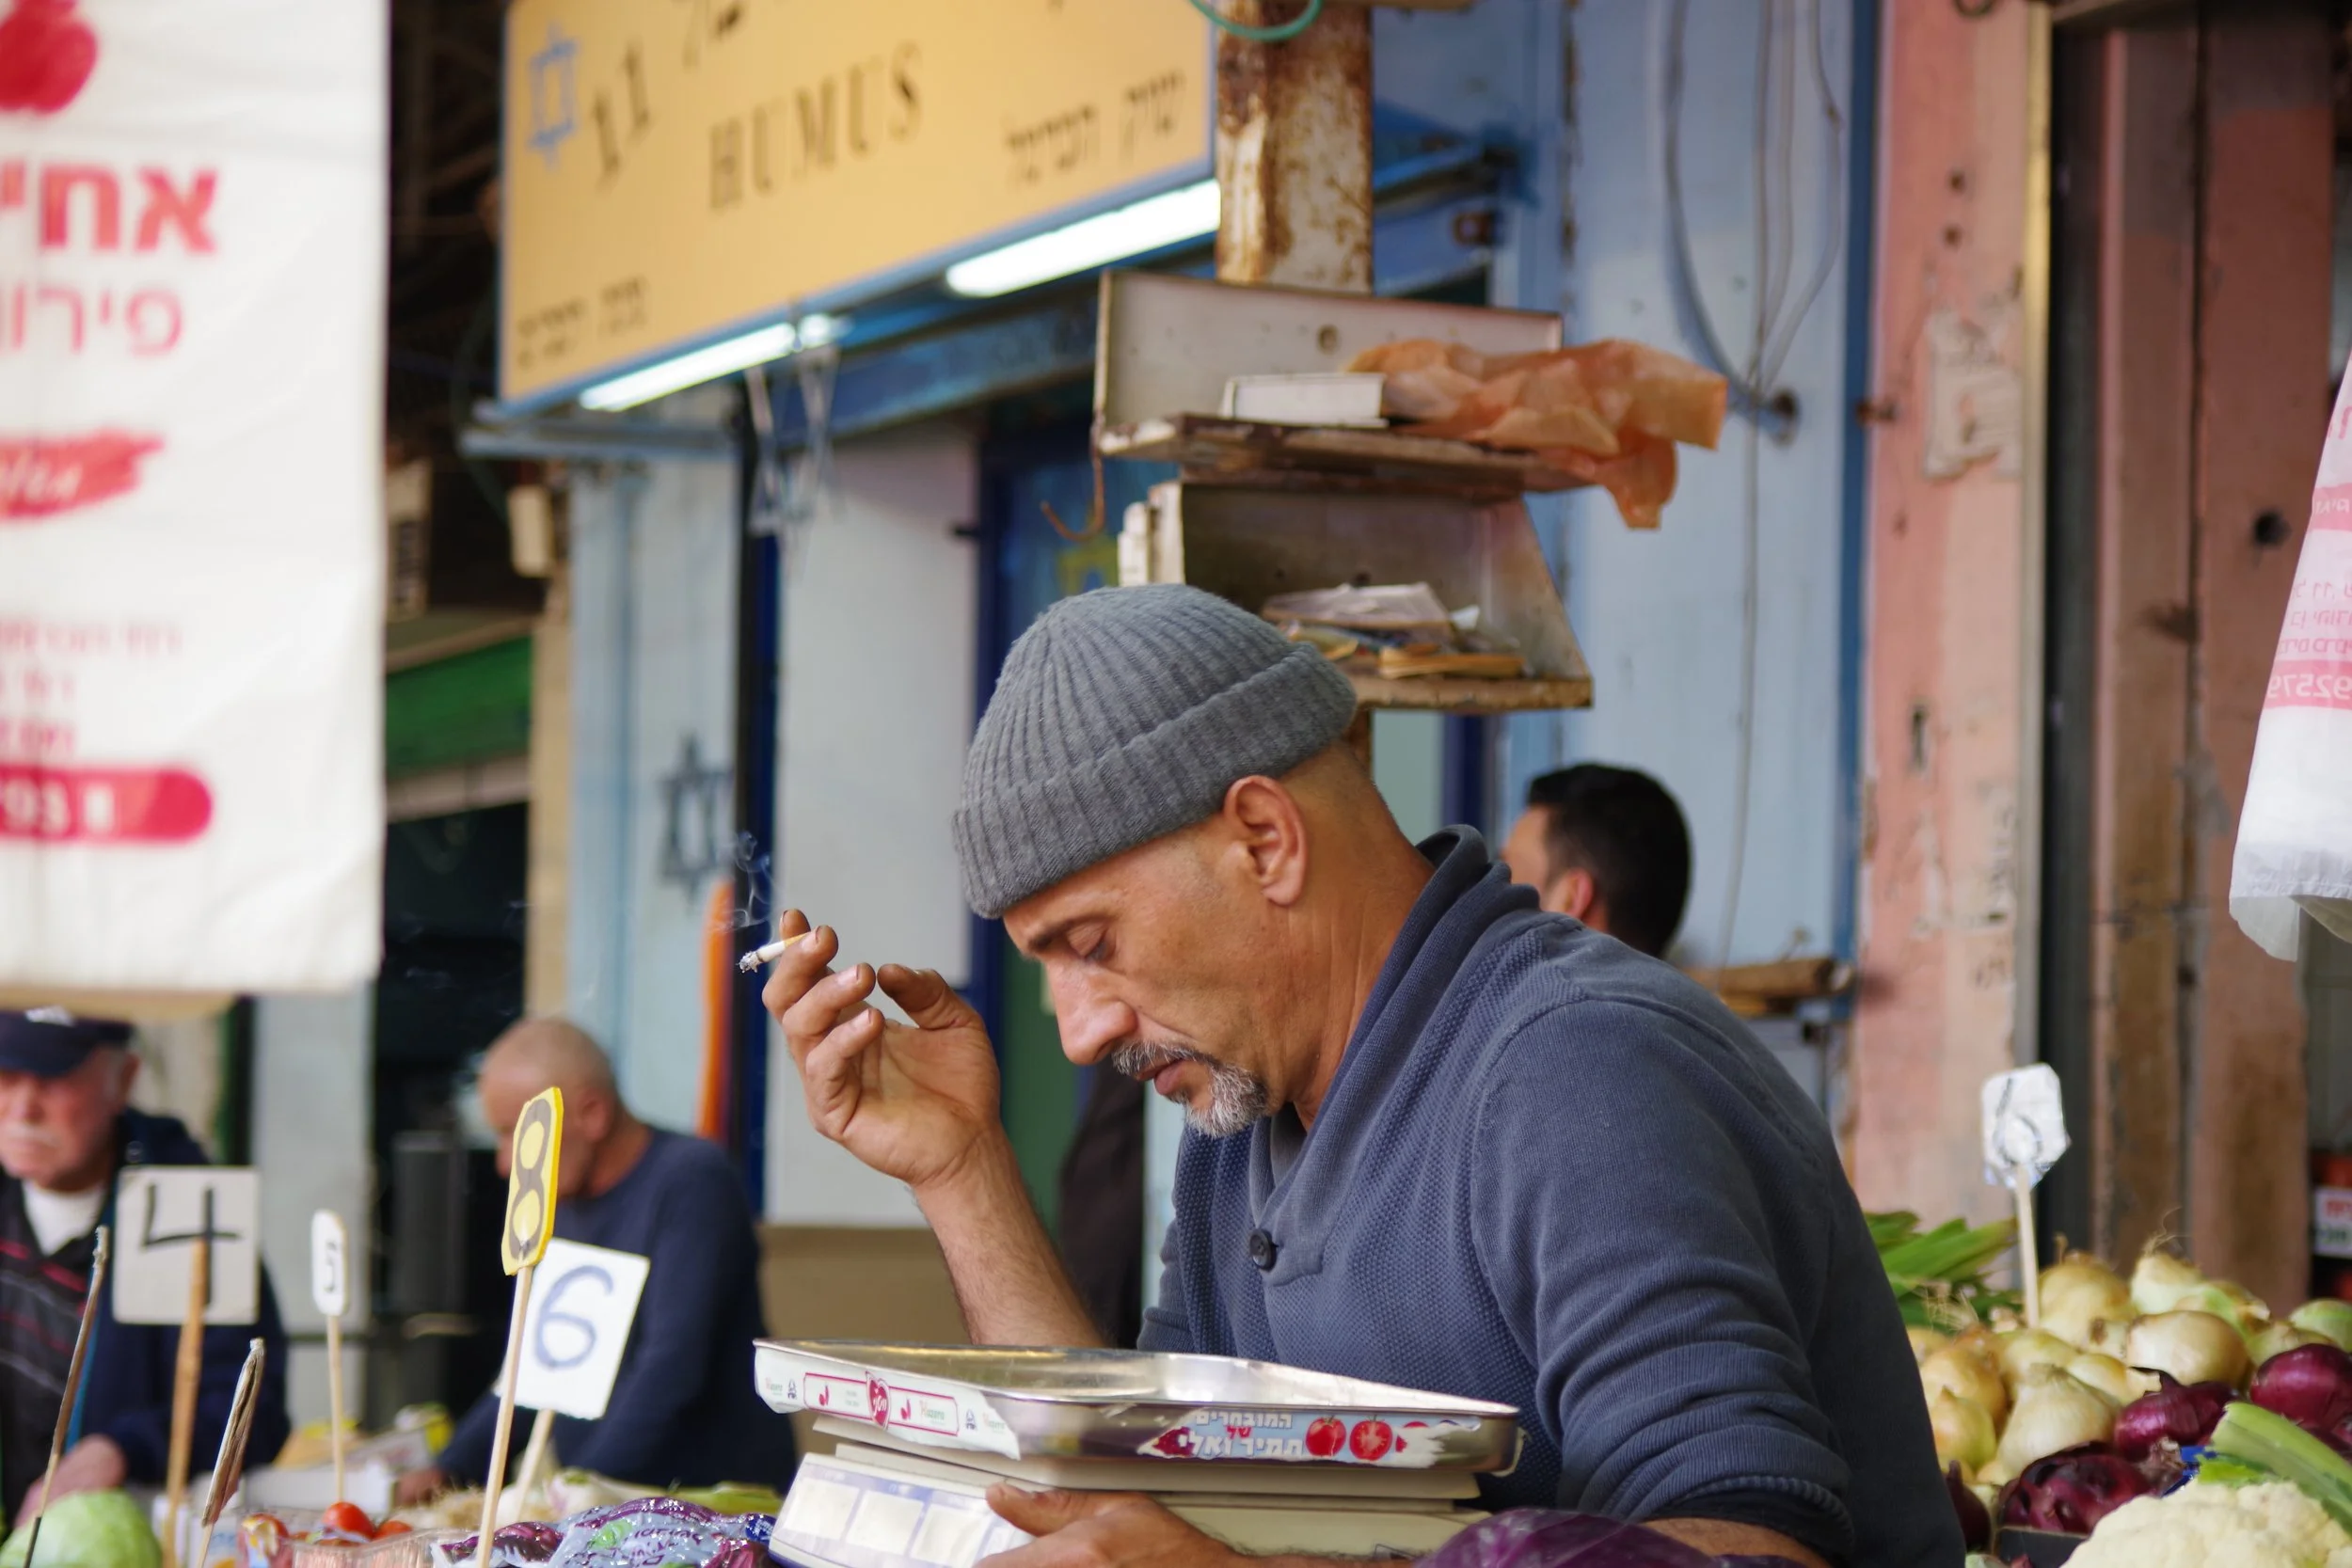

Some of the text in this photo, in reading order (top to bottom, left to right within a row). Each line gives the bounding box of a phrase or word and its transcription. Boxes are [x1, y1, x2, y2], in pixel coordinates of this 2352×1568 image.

[711, 41, 920, 211] HUMUS
[0, 281, 183, 357] פירו
[508, 1097, 552, 1260] 8
[139, 1181, 244, 1307] 4
[533, 1264, 614, 1370] 6
[1196, 1411, 1293, 1429] המובחרים
[1226, 1425, 1253, 1440] של
